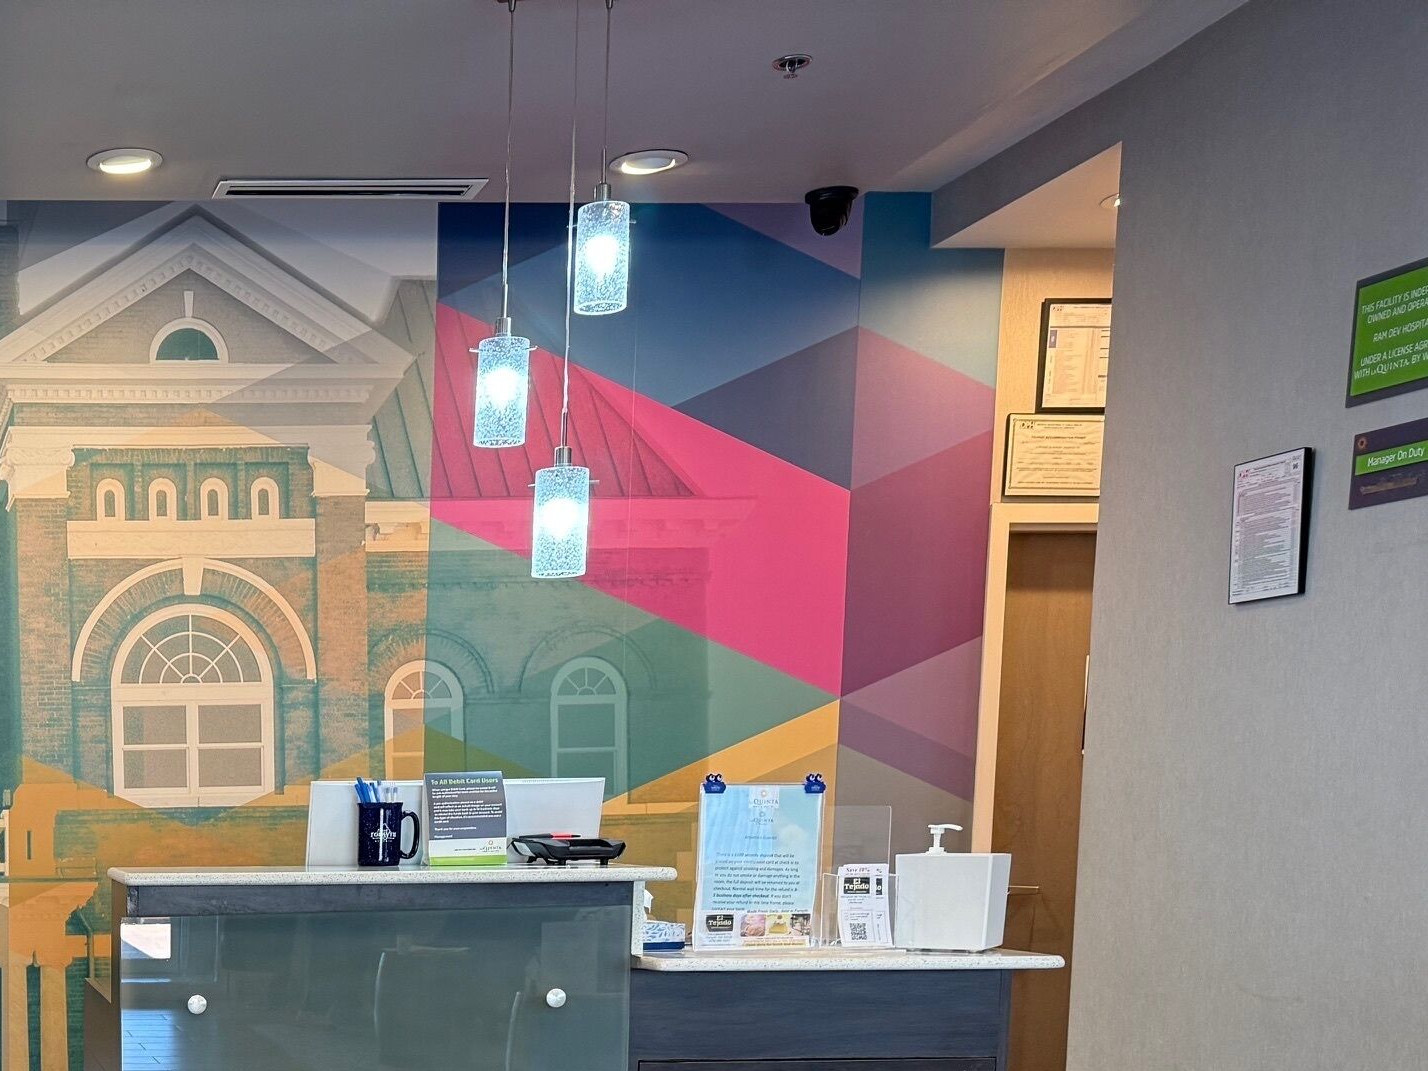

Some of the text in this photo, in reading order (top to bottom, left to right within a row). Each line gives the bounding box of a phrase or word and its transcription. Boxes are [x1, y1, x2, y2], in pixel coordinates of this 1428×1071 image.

[1376, 294, 1402, 310] FACILITY
[1367, 309, 1391, 324] OWNED
[1392, 304, 1406, 317] AND
[1360, 353, 1382, 366] UNDER
[1388, 343, 1413, 359] LICENSE
[1354, 368, 1371, 380] WITH
[1367, 447, 1426, 467] Manager On Duty
